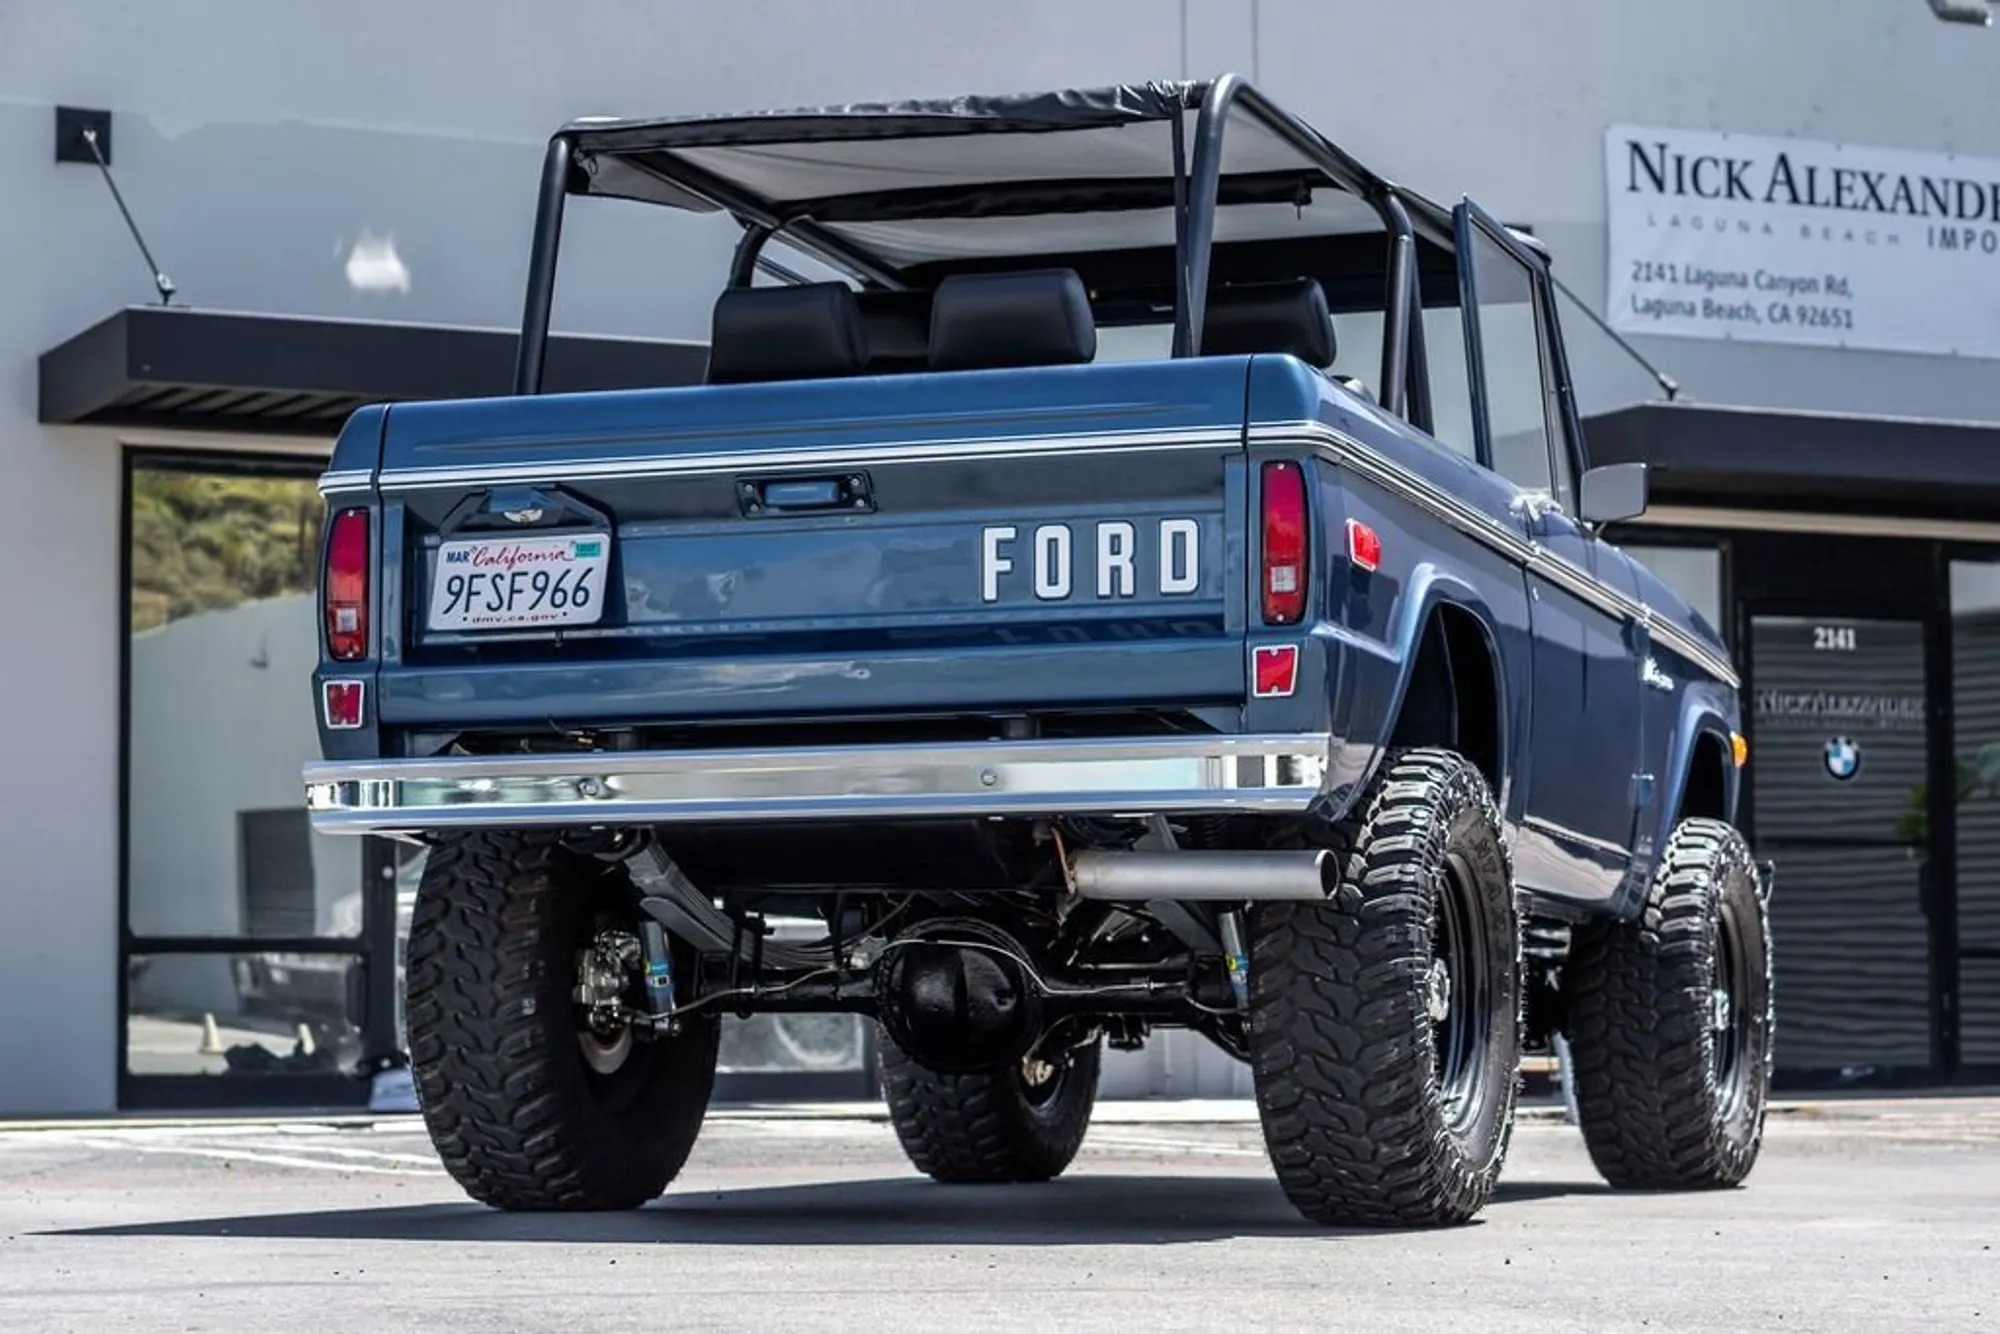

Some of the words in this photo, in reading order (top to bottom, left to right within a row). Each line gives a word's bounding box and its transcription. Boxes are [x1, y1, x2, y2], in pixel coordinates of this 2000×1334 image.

[1626, 139, 1754, 202] NICK
[1647, 213, 1774, 236] LAGUNA
[1799, 226, 1900, 246] BEACH
[1927, 225, 1998, 254] IMPO
[1631, 260, 1679, 283] 2141
[1685, 263, 1749, 292] Laguna
[1754, 269, 1819, 298] Canyon
[1825, 275, 1854, 299] Rd,
[1631, 293, 1697, 320] Laguna
[1703, 298, 1762, 325] Beach,
[1768, 302, 1791, 323] CA
[1797, 306, 1854, 329] 92651
[445, 551, 470, 563] MAR
[471, 545, 575, 571] California
[982, 518, 1199, 602] FORD
[442, 566, 595, 615] 9FSF966
[1813, 626, 1857, 650] 2141
